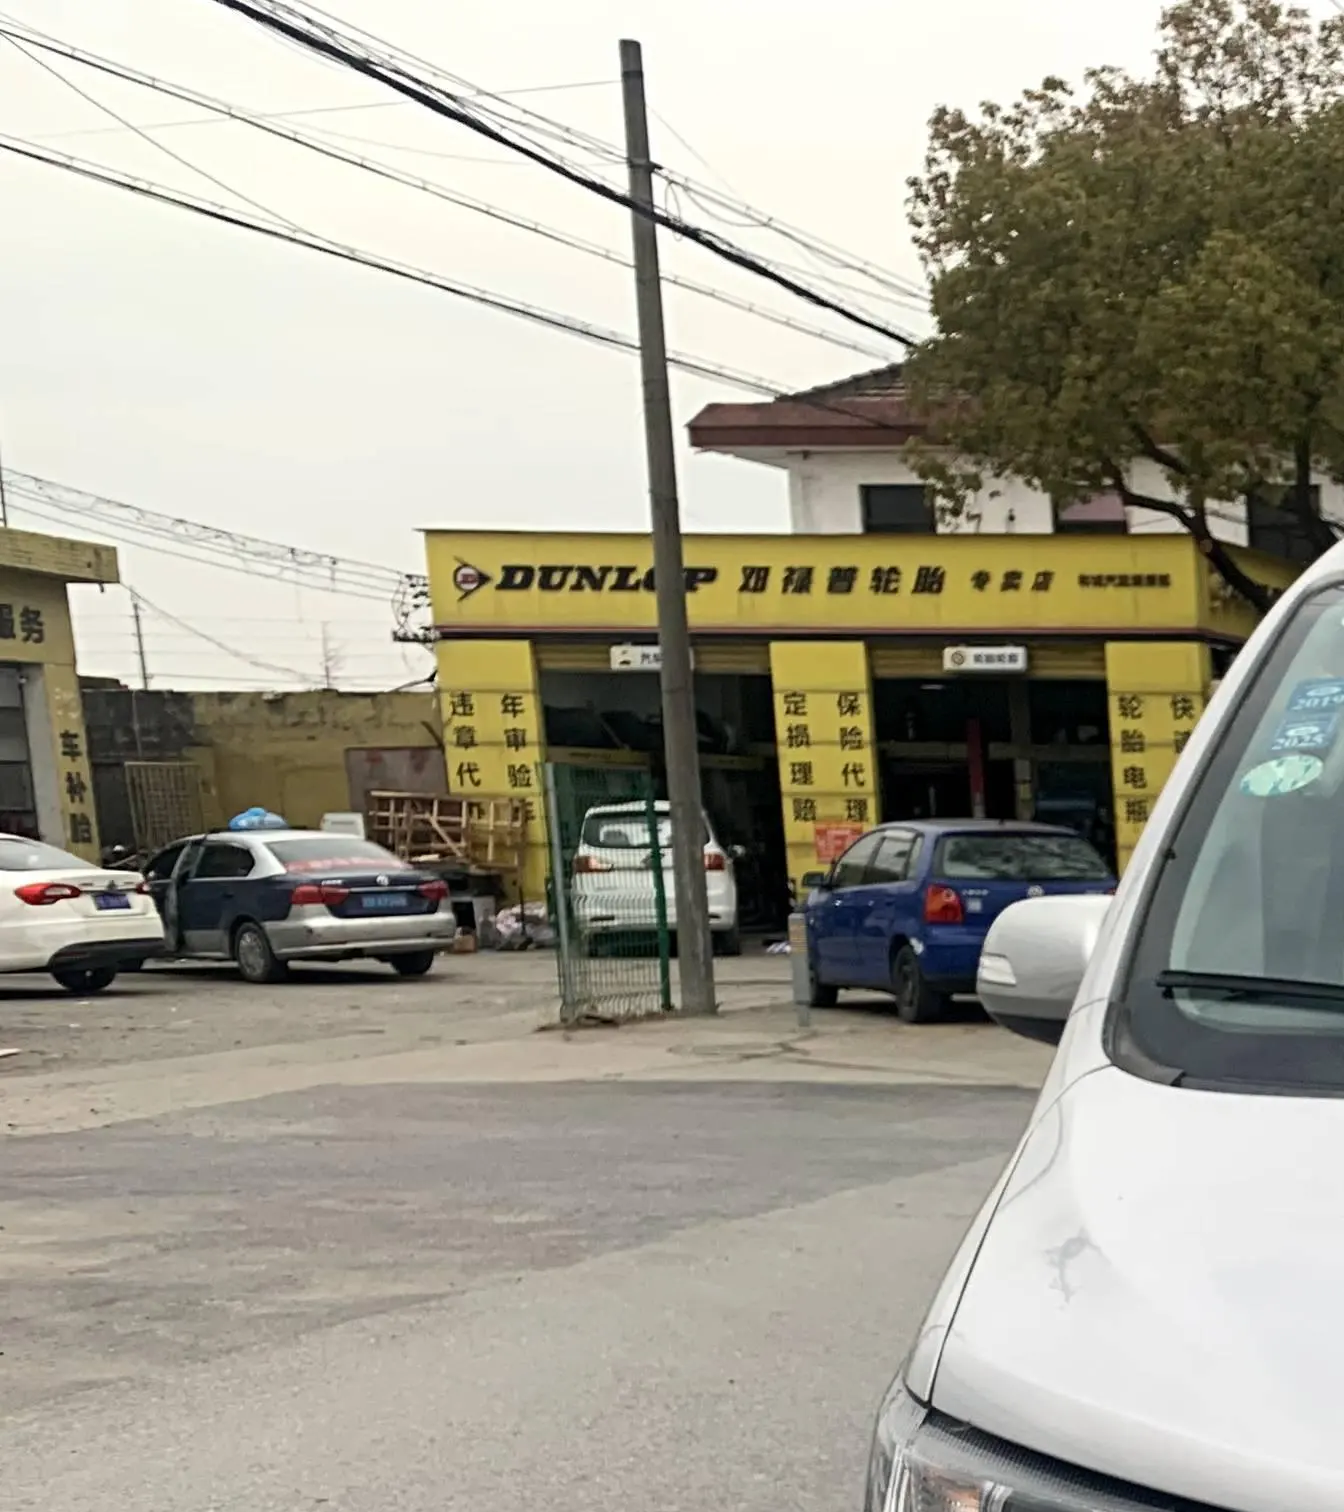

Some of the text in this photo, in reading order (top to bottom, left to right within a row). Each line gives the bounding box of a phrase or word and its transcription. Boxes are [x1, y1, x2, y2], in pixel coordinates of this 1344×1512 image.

[784, 691, 817, 822] 定损理赔
[837, 692, 868, 822] 保险代理
